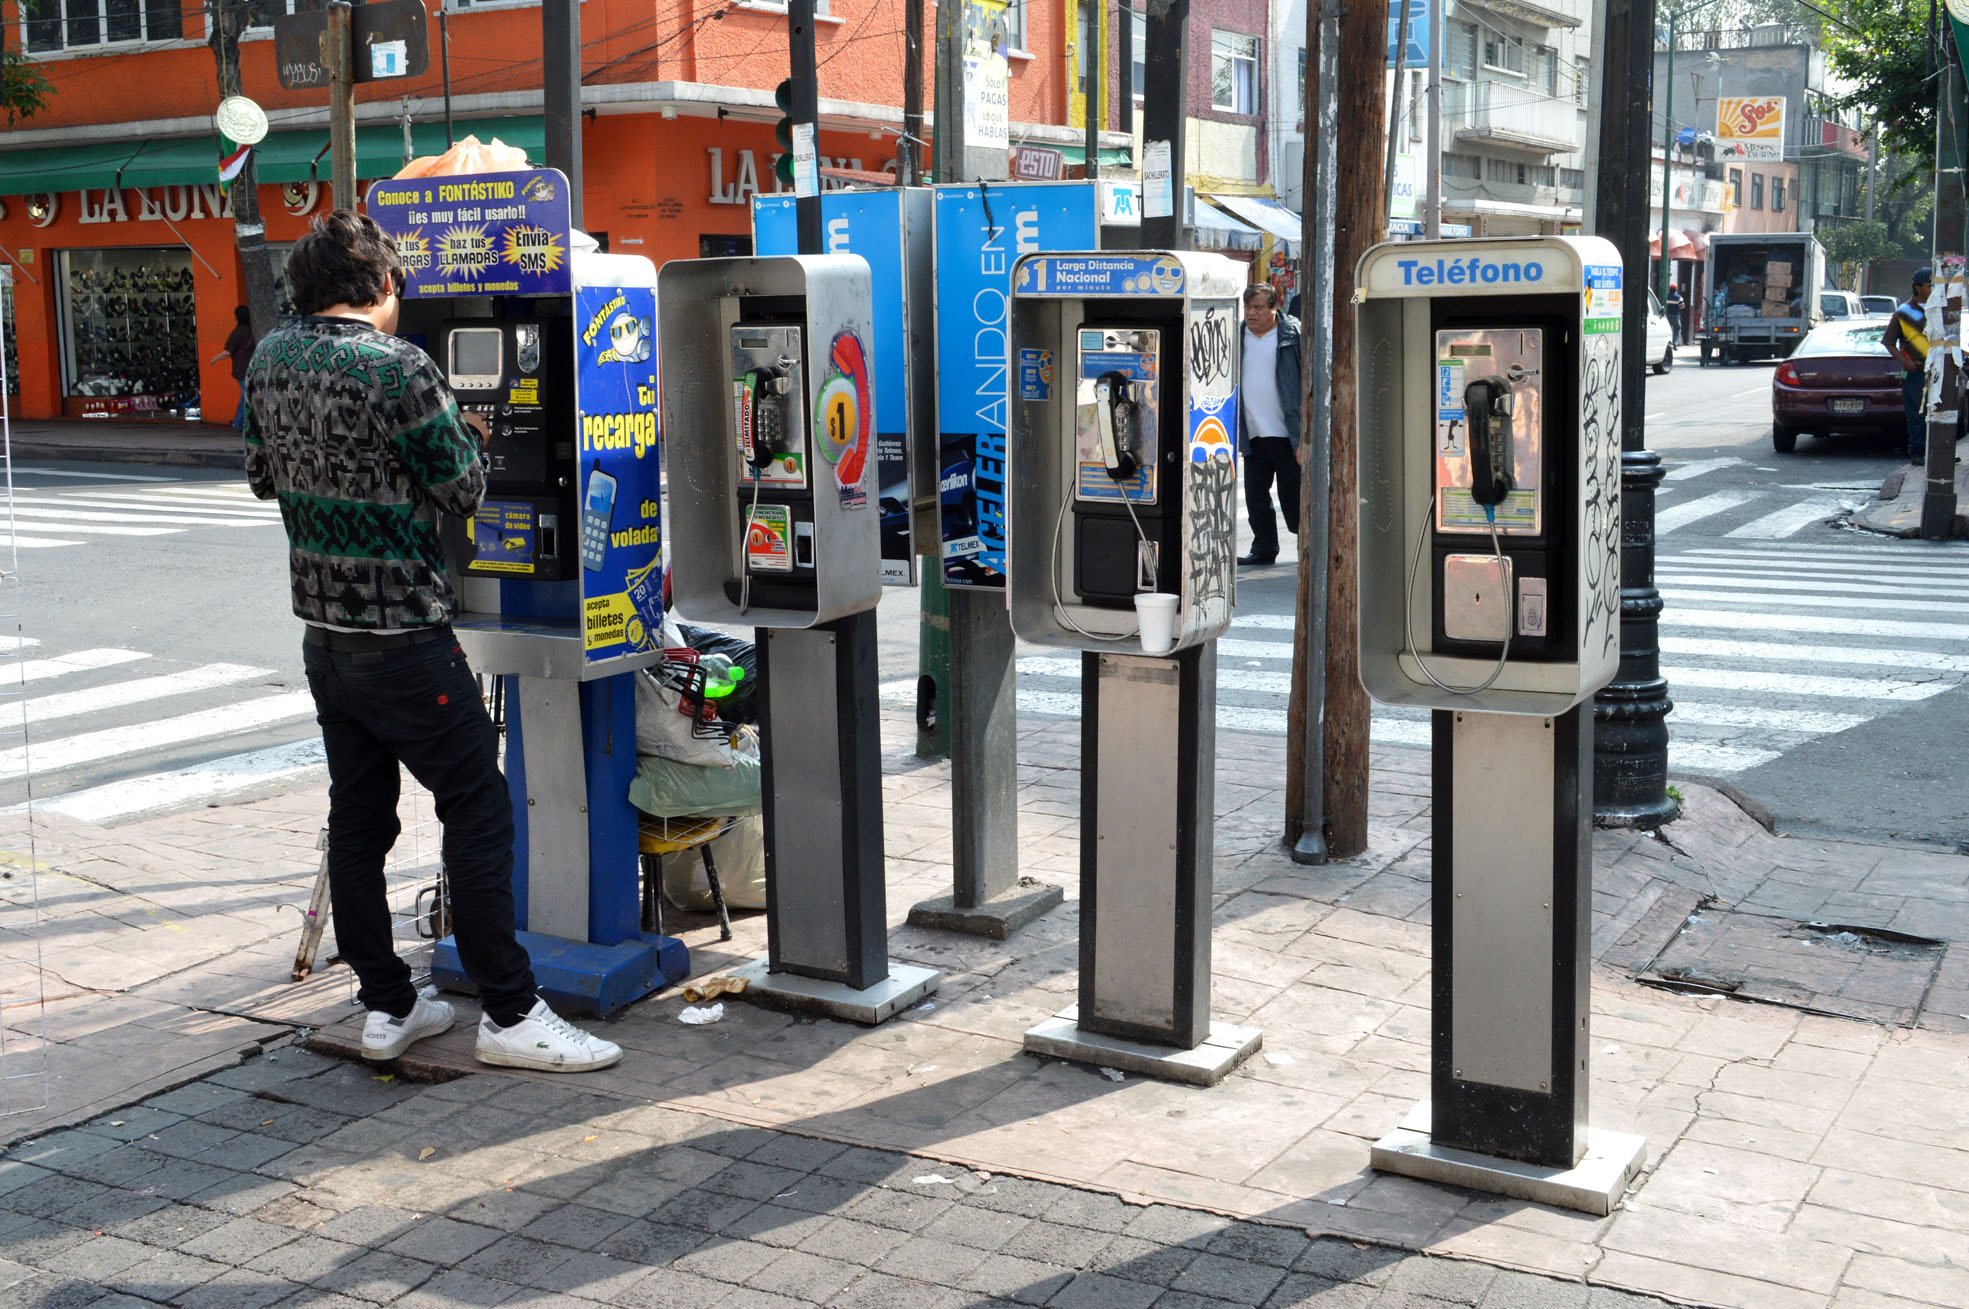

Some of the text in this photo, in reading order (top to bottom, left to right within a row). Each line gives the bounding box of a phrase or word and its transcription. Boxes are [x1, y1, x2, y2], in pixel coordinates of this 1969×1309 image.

[981, 93, 1007, 106] PAGAS
[983, 112, 1002, 125] LO QUE
[978, 125, 1007, 139] HABLAS
[708, 147, 760, 204] LA
[378, 180, 514, 206] Conoce a FONTÁSTIKO
[79, 183, 233, 223] LA LUNA
[432, 210, 453, 224] muy
[458, 207, 480, 222] fácil
[485, 205, 526, 220] usarlo!!
[405, 241, 420, 251] tus
[450, 236, 486, 250] haz tus
[440, 250, 498, 266] LLAMADAS
[521, 252, 546, 270] SMS
[1056, 260, 1134, 274] Larga Distancia
[1397, 258, 1543, 286] Teléfono
[1056, 272, 1110, 283] Nacional
[418, 281, 519, 294] acepta billetes y monedas
[583, 296, 626, 346] FONTÁSTIKO
[583, 412, 656, 459] recarga
[505, 511, 530, 520] cámara
[641, 500, 658, 518] de
[505, 521, 531, 530] de video
[611, 526, 658, 548] volada
[958, 542, 980, 551] TELMEX
[633, 584, 646, 600] 20
[586, 599, 610, 611] acepta
[587, 613, 624, 629] billetes
[594, 628, 624, 643] monedas
